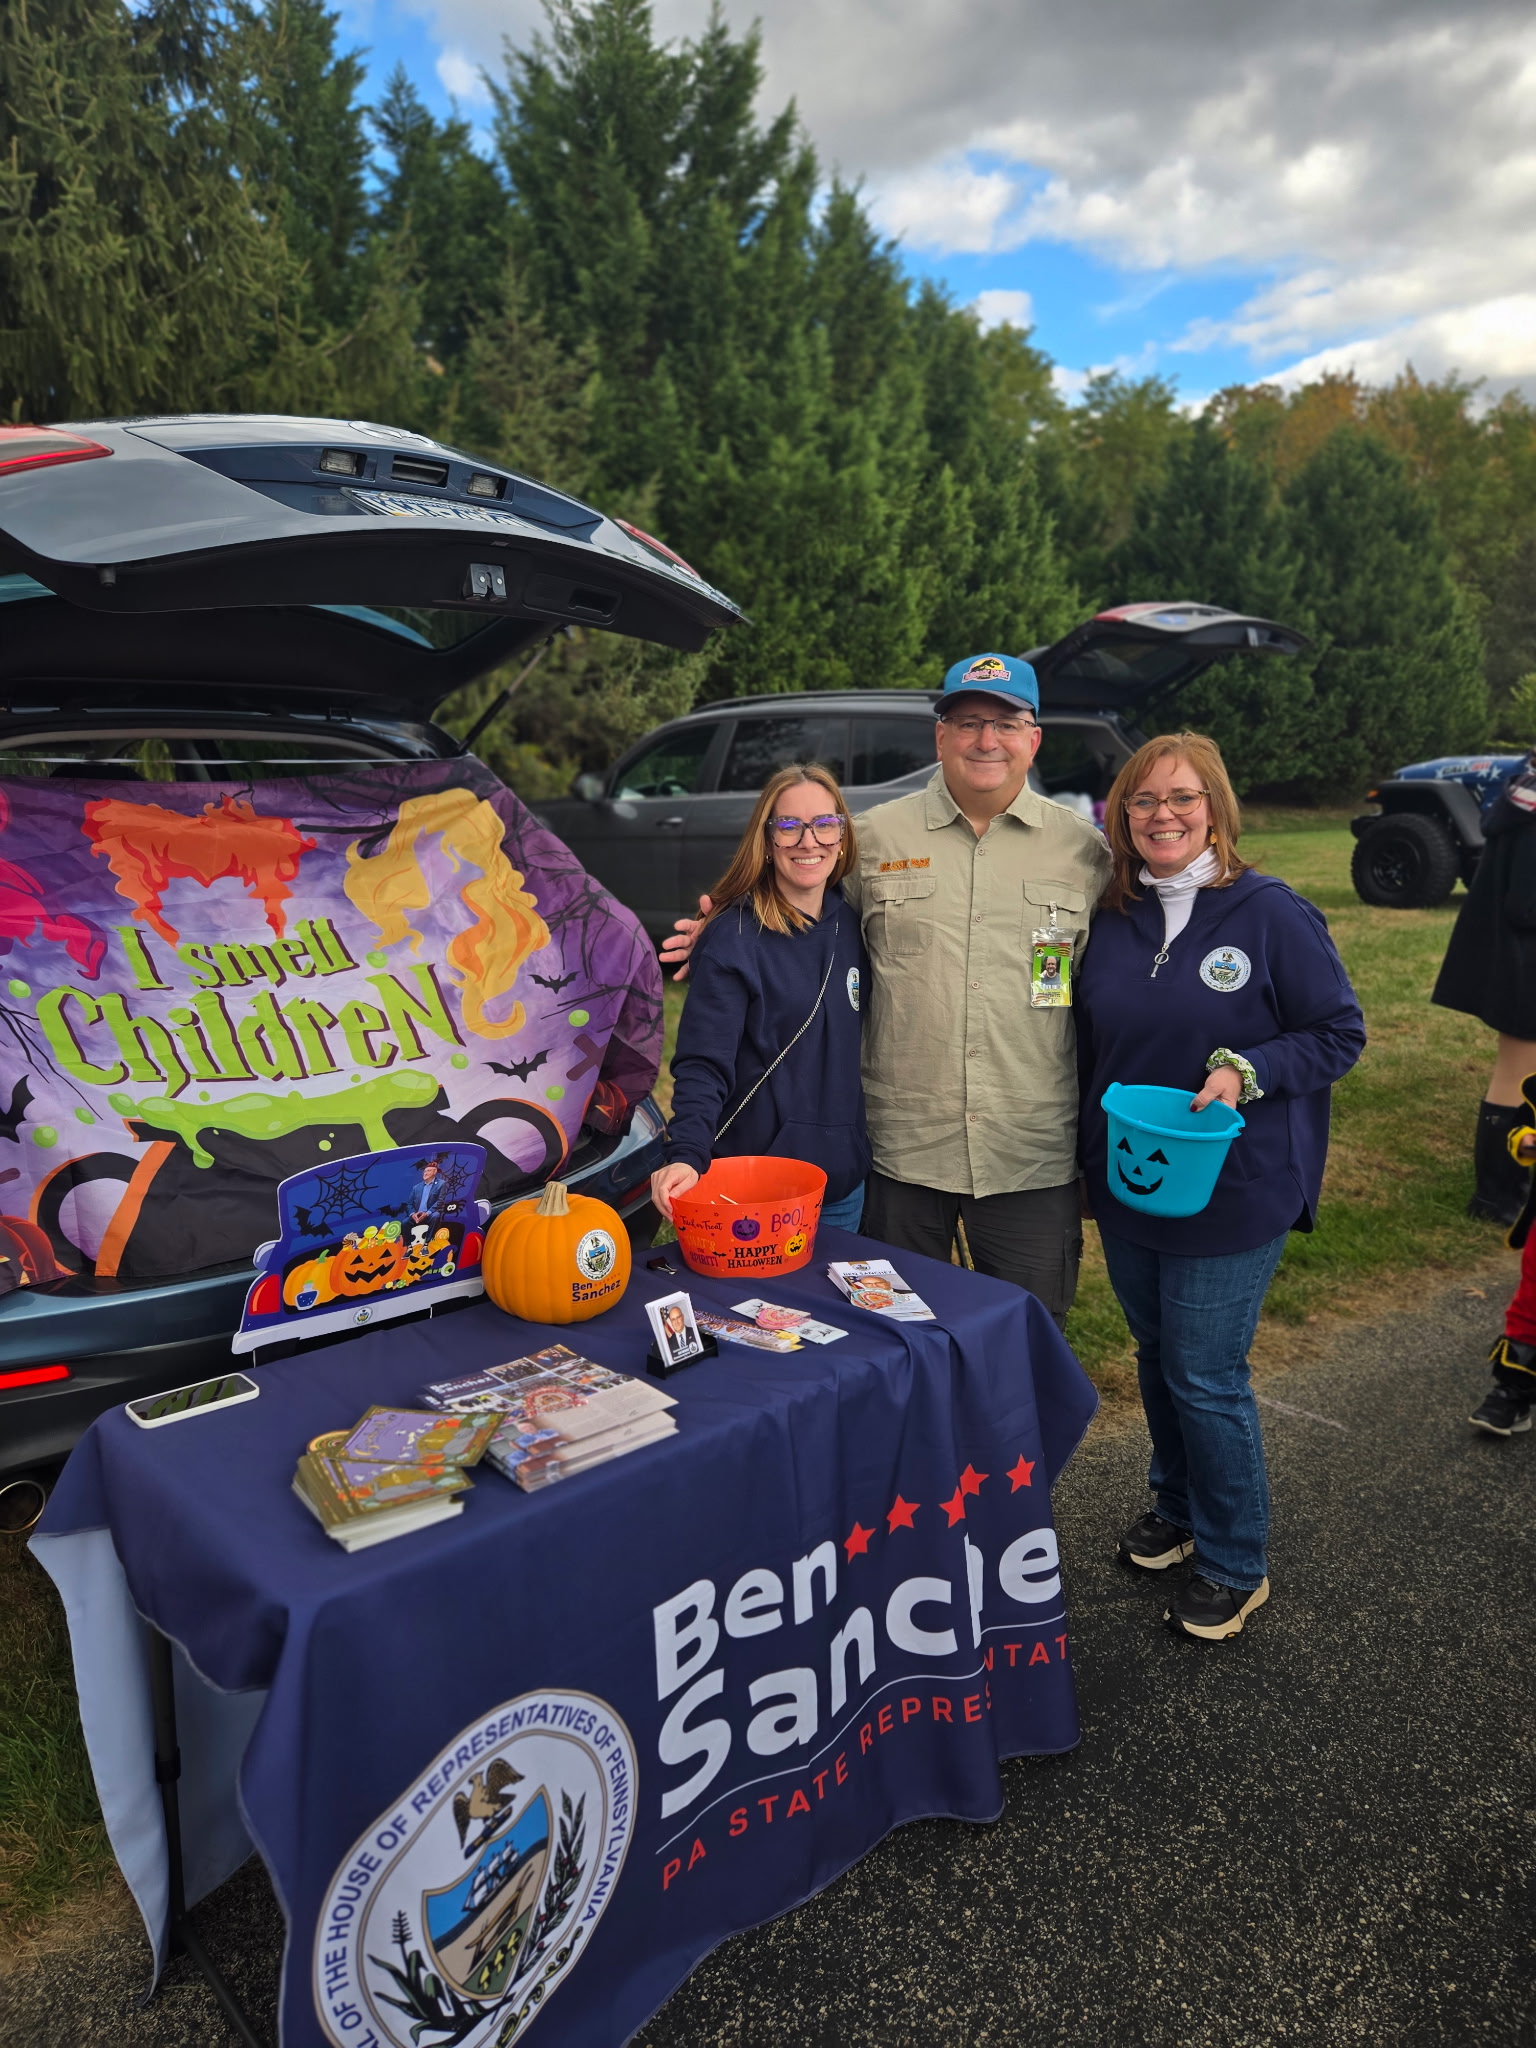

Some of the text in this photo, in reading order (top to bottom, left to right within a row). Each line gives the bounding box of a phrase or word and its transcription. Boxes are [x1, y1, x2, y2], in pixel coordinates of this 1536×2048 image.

[115, 916, 360, 990] I smell
[702, 1220, 723, 1231] Treat
[727, 1255, 783, 1269] HALLOWEEN
[733, 1243, 779, 1259] HAPPY
[572, 1282, 593, 1292] Ben
[572, 1279, 621, 1302] Sanchez
[653, 1540, 837, 1701] Ben
[593, 1723, 616, 1750] OF
[410, 1702, 597, 1815] REPRESENTATIVES
[376, 1813, 409, 1850] OF
[581, 1746, 629, 1923] PENNSYLVANIA
[662, 1838, 706, 1891] PA
[728, 1752, 849, 1836] STATE
[328, 1851, 382, 1942] HOUSE
[325, 1946, 349, 2000] THE
[332, 2001, 363, 2030] OF
